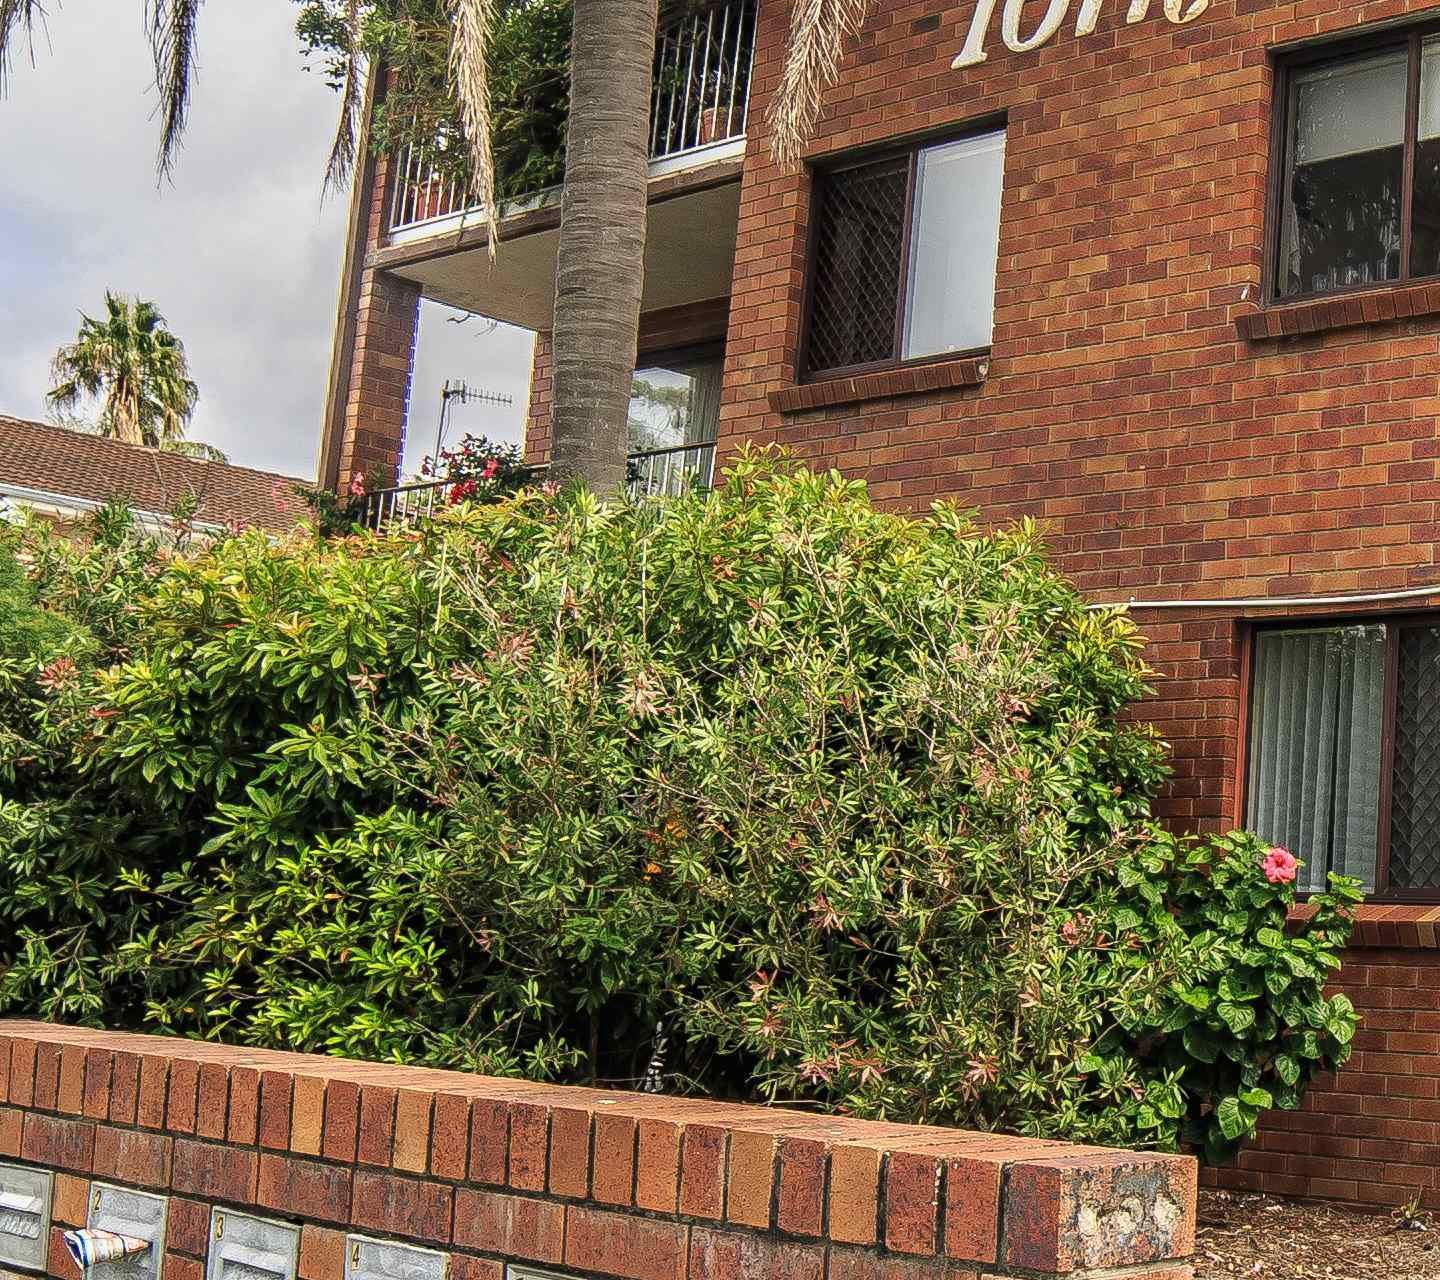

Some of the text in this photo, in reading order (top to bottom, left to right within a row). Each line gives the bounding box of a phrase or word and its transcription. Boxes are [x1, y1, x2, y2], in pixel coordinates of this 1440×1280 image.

[94, 1190, 102, 1211] 2
[216, 1217, 224, 1238] 3
[351, 1244, 360, 1268] 4
